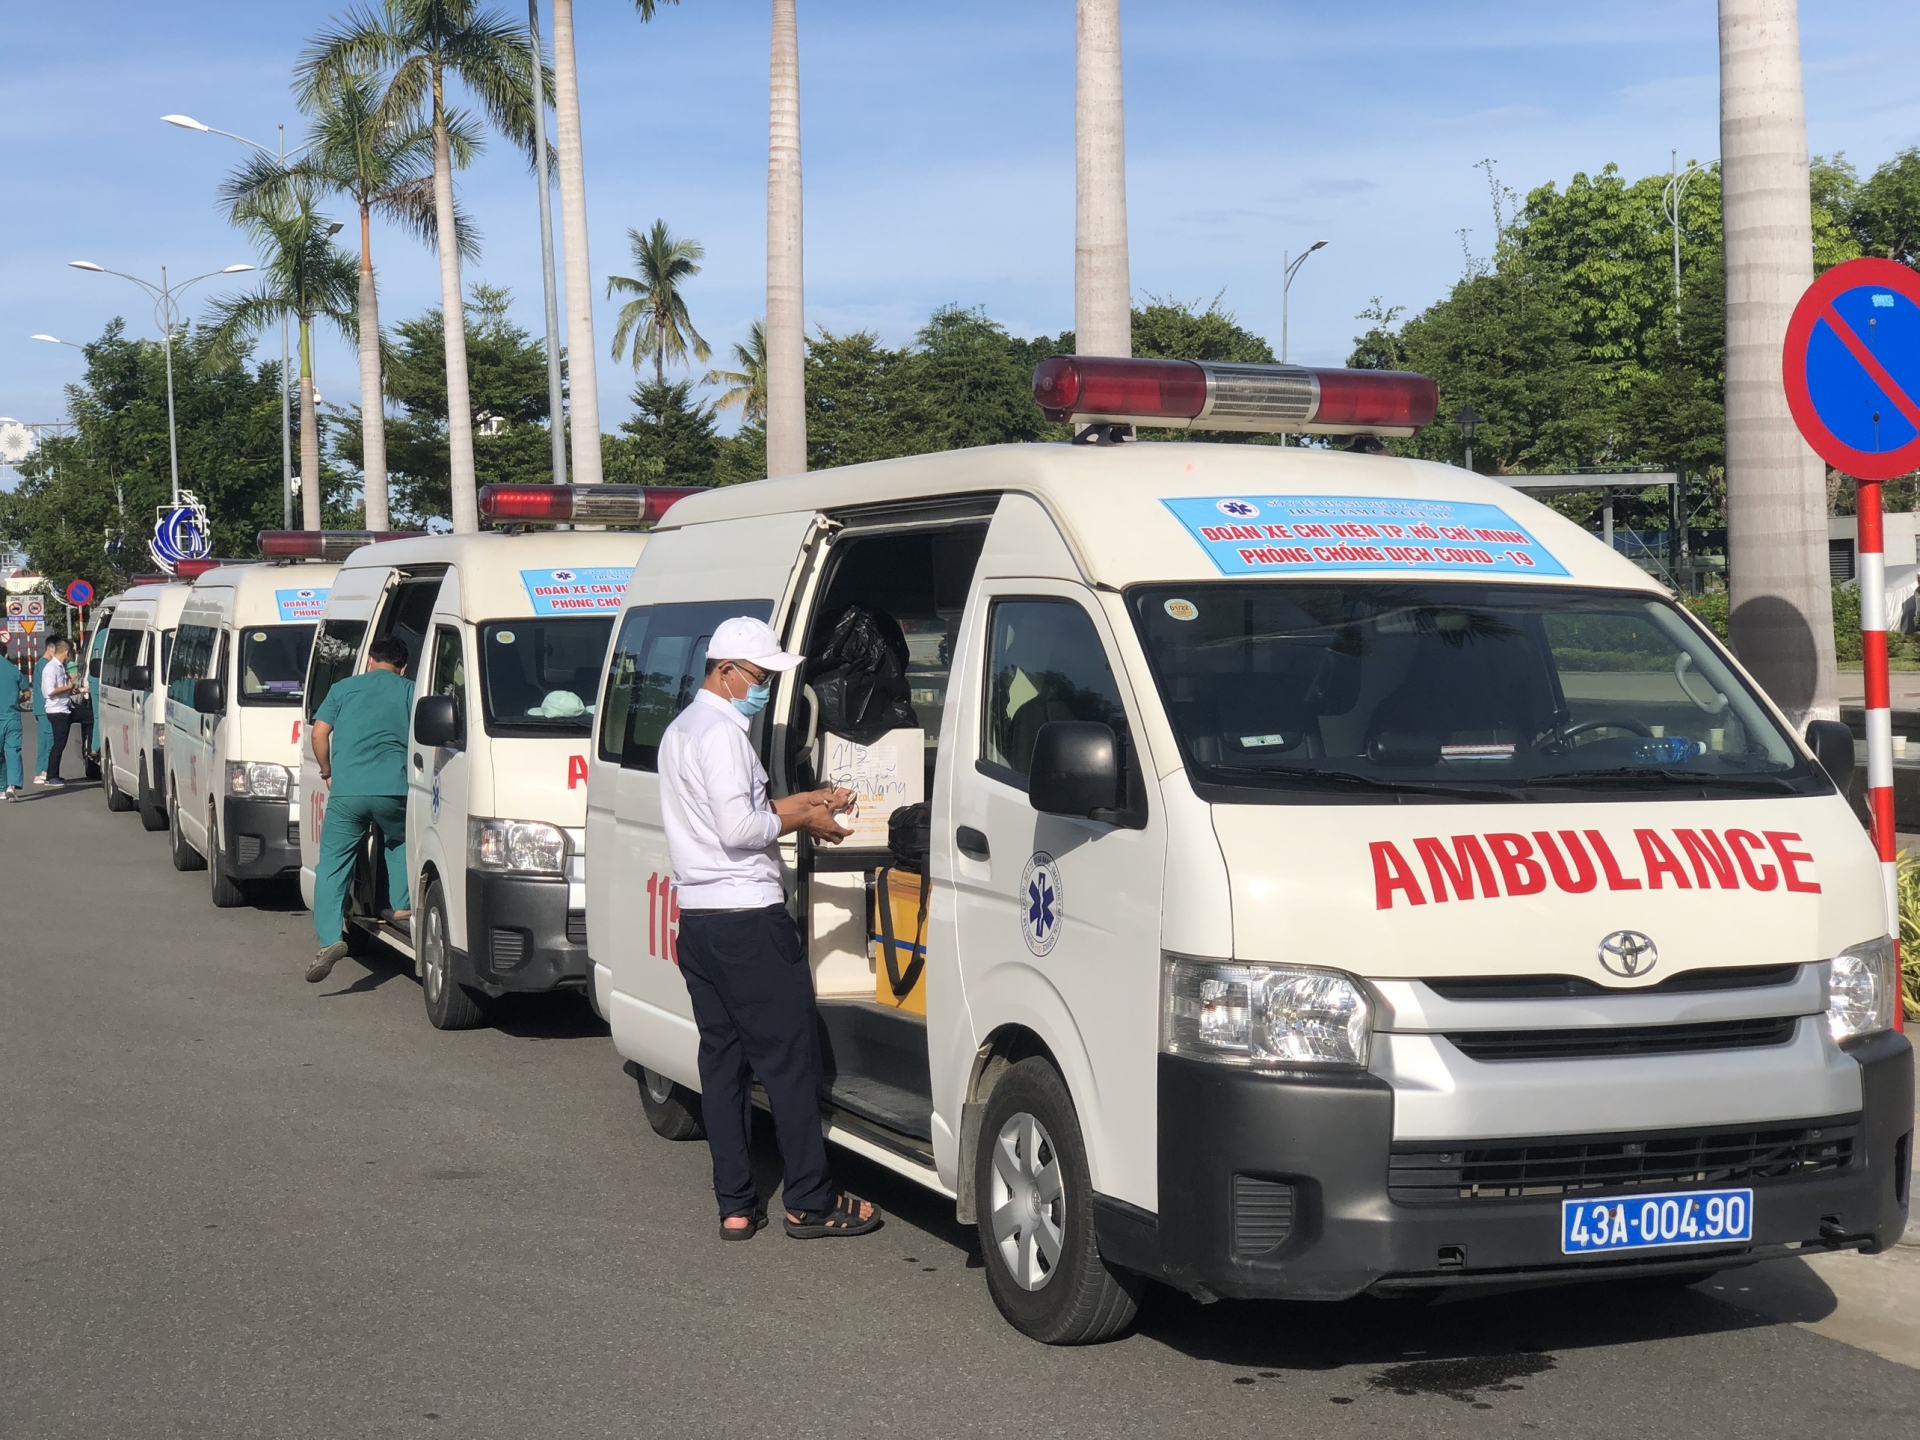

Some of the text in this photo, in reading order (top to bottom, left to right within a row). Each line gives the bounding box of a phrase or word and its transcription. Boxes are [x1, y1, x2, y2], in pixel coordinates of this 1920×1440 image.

[1201, 521, 1531, 544] ĐOÀN XE CHI VIỆN TP. HỒ CHÍ MINH
[1238, 544, 1315, 564] PHÒNG
[1312, 542, 1387, 562] CHỐNG
[1383, 546, 1437, 564] DỊCH
[1433, 547, 1495, 564] COVID
[1505, 551, 1535, 566] 19
[535, 584, 570, 596] ĐOÀN
[572, 585, 588, 594] XE
[591, 584, 613, 594] CHI
[551, 595, 622, 609] PHÒNG CHỐ
[832, 739, 868, 772] 115
[1368, 828, 1822, 911] AMBULANCE
[1570, 1196, 1745, 1247] 43A-004.90
